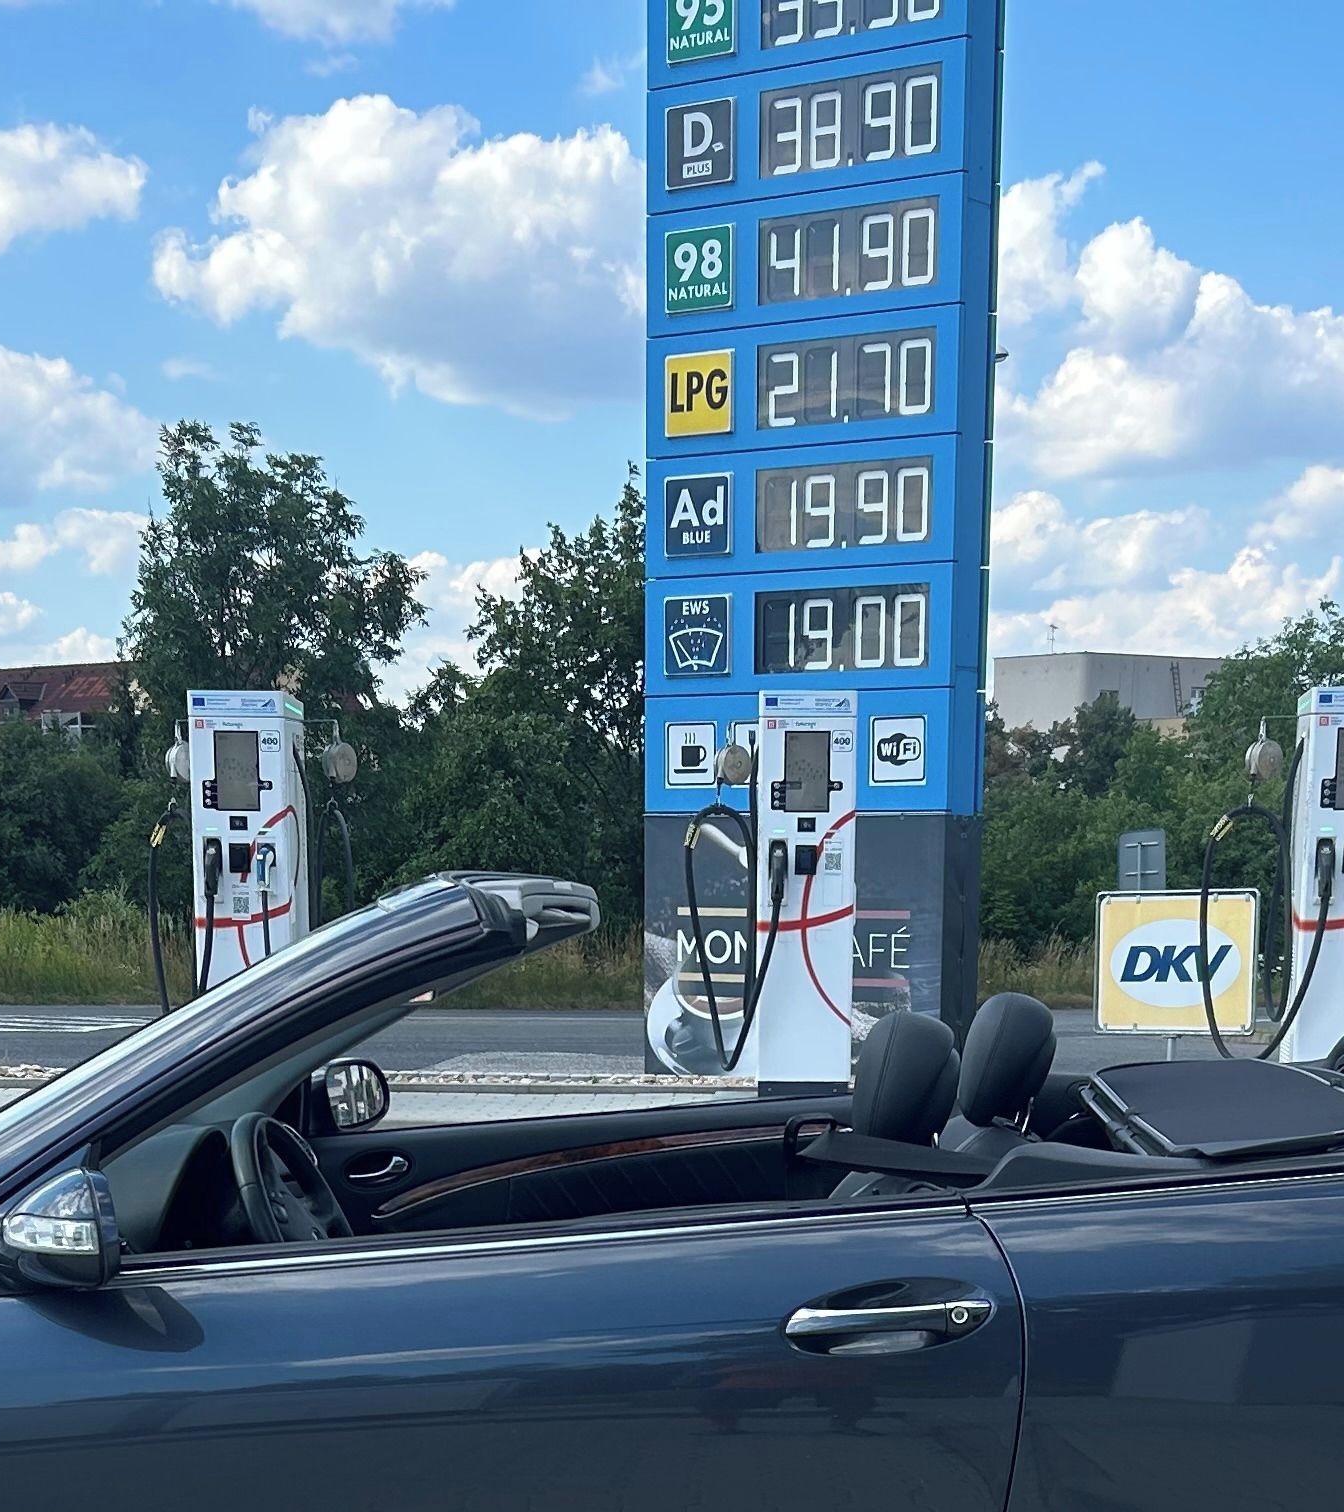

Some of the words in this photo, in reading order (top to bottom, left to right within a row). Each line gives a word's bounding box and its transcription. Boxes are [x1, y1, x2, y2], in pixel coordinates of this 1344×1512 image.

[669, 27, 730, 51] NATURAL
[772, 74, 938, 176] 38.90
[686, 162, 711, 176] PLUS
[673, 238, 724, 283] 98
[769, 207, 935, 297] 41.90
[668, 280, 728, 302] NATURAL
[670, 368, 728, 414] LPG
[768, 337, 932, 428] 21.70
[669, 485, 725, 529] Ad
[790, 466, 929, 549] 19.90
[682, 529, 711, 545] BLUE
[682, 600, 710, 616] EWS
[788, 593, 926, 673] 19.00
[261, 737, 278, 746] 400
[833, 737, 851, 746] 400
[1119, 944, 1234, 983] DKV
